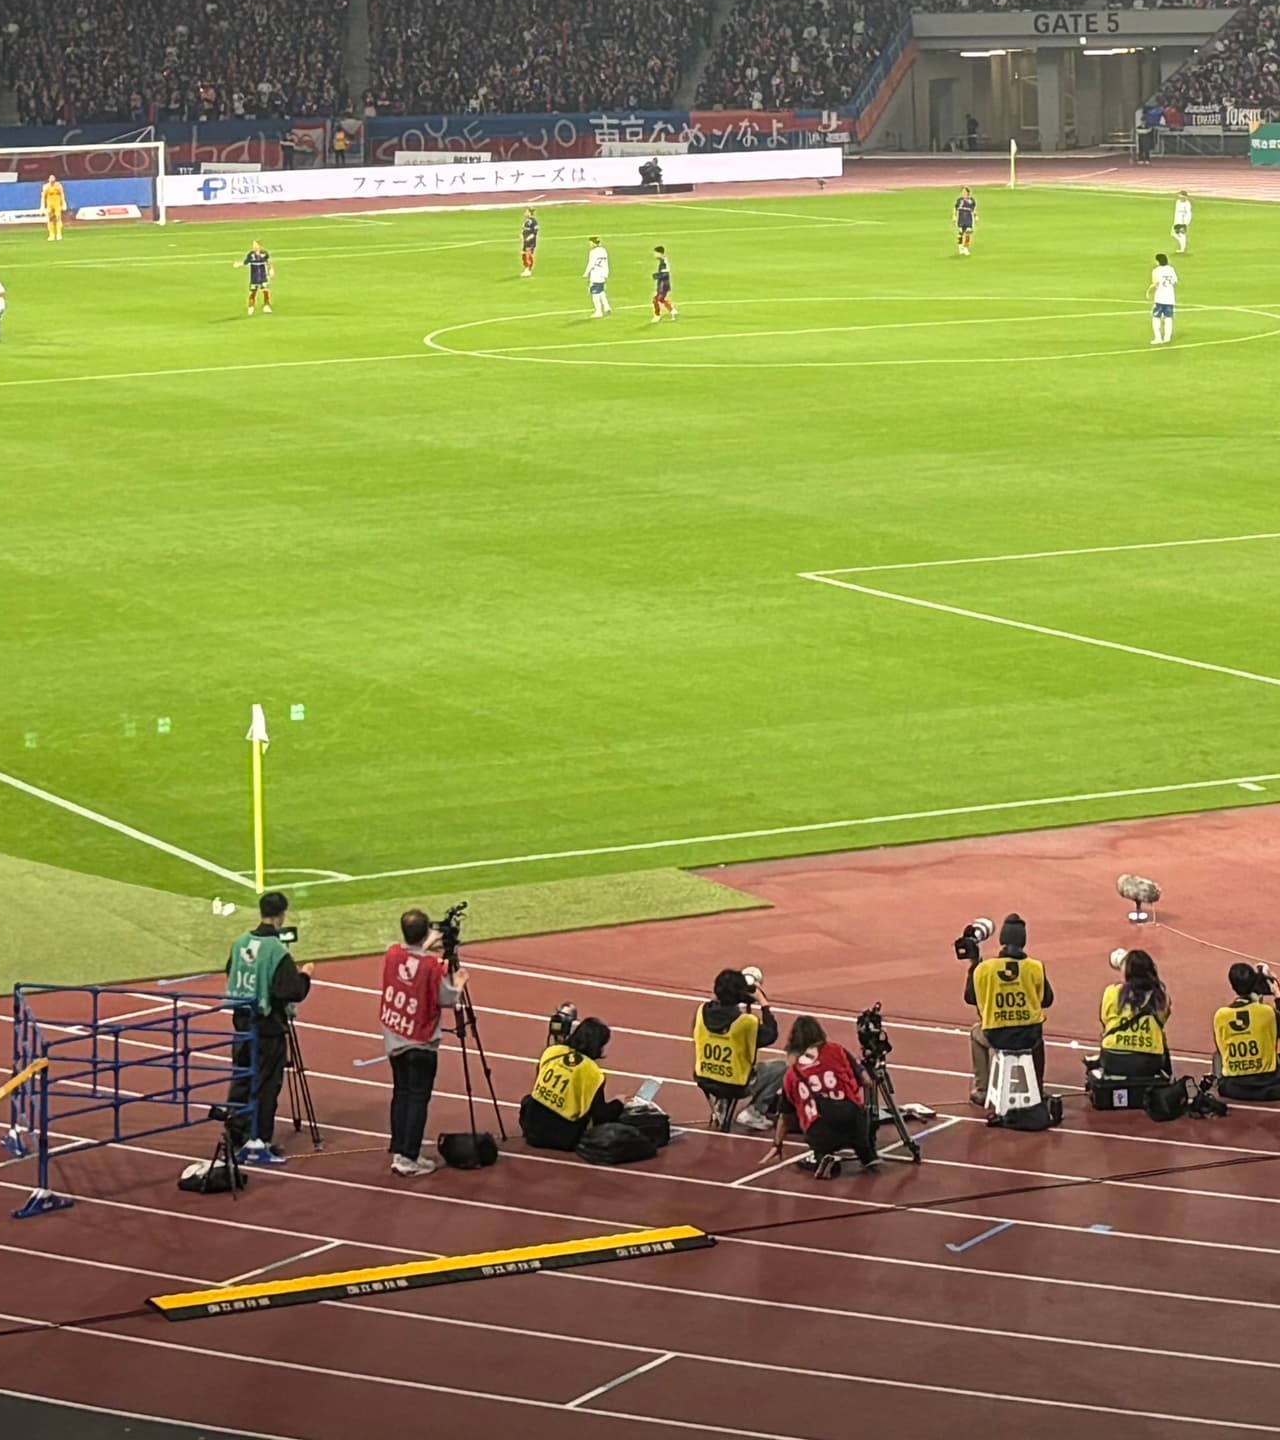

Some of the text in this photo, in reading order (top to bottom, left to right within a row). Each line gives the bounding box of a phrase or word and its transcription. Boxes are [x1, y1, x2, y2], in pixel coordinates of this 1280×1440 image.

[1034, 13, 1119, 33] GATE 5
[384, 985, 417, 1015] 003
[996, 991, 1026, 1009] 003
[994, 1009, 1031, 1022] PRESS
[1116, 1034, 1153, 1047] PRESS
[1229, 1040, 1259, 1058] 008
[703, 1043, 733, 1064] 002
[700, 1062, 733, 1077] PRESS
[1228, 1058, 1263, 1072] PRESS
[542, 1068, 571, 1095] 011
[535, 1085, 566, 1109] PRESS
